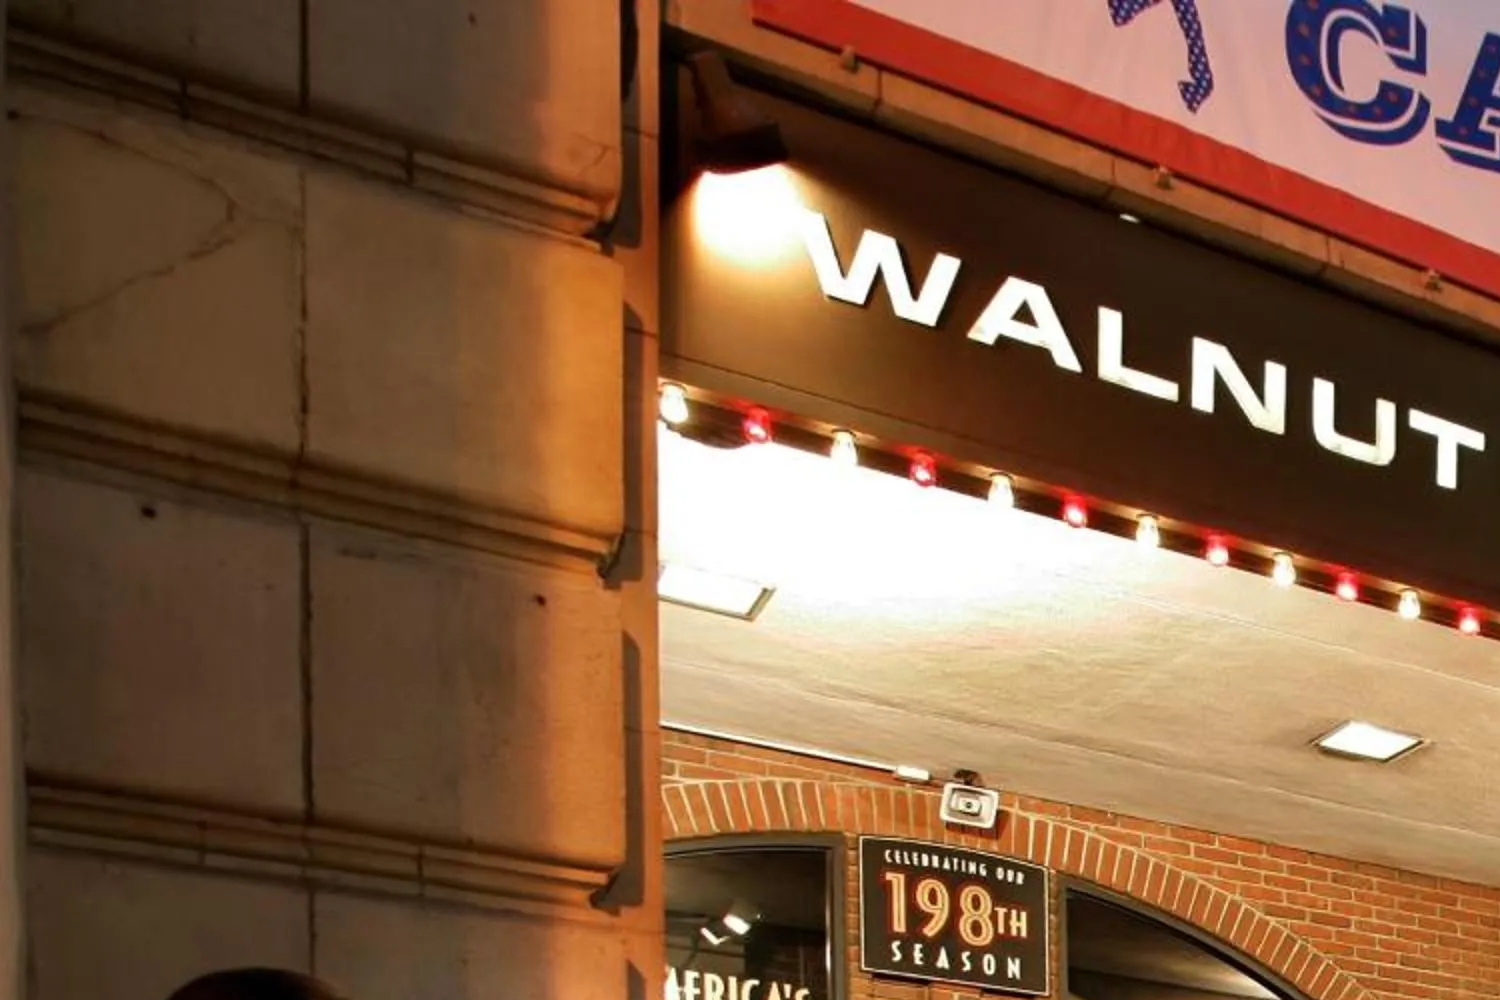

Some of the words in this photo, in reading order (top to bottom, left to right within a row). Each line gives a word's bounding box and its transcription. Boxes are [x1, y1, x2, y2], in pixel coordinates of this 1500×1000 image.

[800, 206, 1486, 490] WALNUT
[884, 849, 987, 877] CELEBRATING
[996, 867, 1025, 886] OUR
[885, 872, 1028, 947] 198TH
[891, 940, 1022, 981] SEASON
